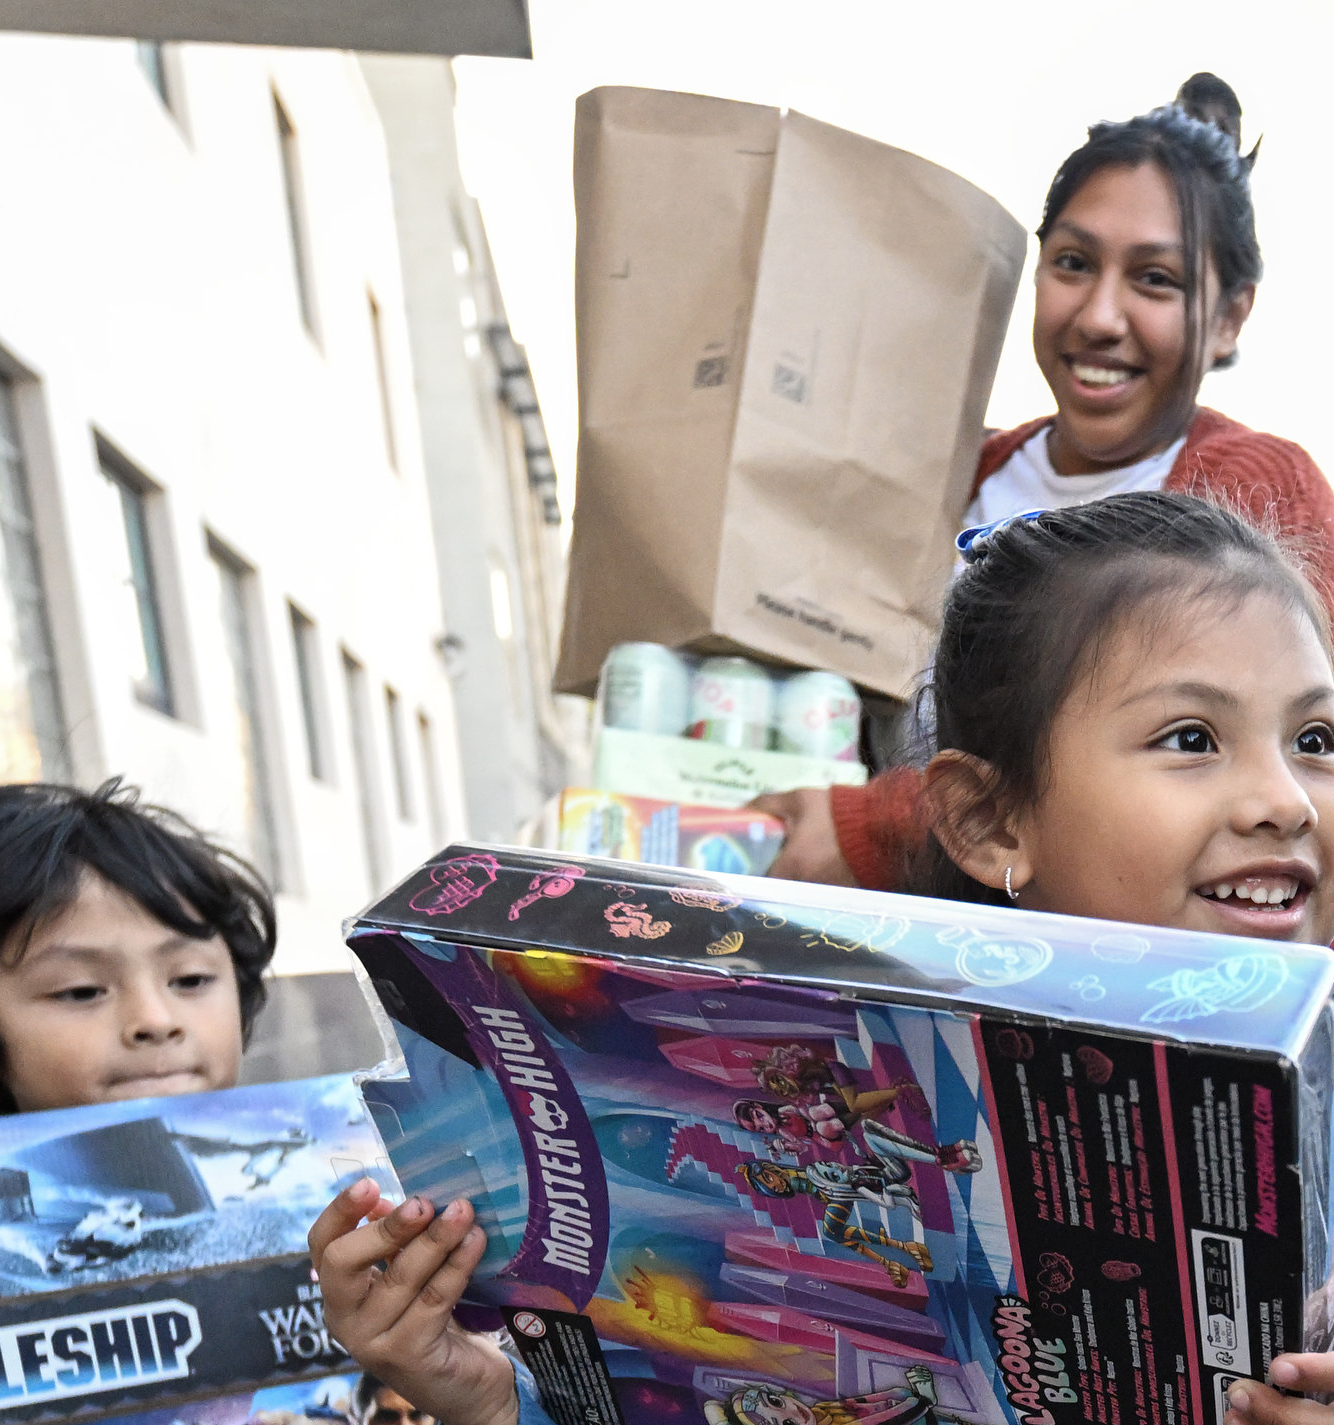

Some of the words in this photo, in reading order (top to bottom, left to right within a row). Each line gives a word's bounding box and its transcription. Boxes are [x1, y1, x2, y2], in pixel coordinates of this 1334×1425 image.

[472, 1006, 558, 1090] HIGH
[542, 1130, 591, 1275] MONSTER
[994, 1307, 1056, 1425] LAGOONA
[1031, 1336, 1078, 1404] BLUE
